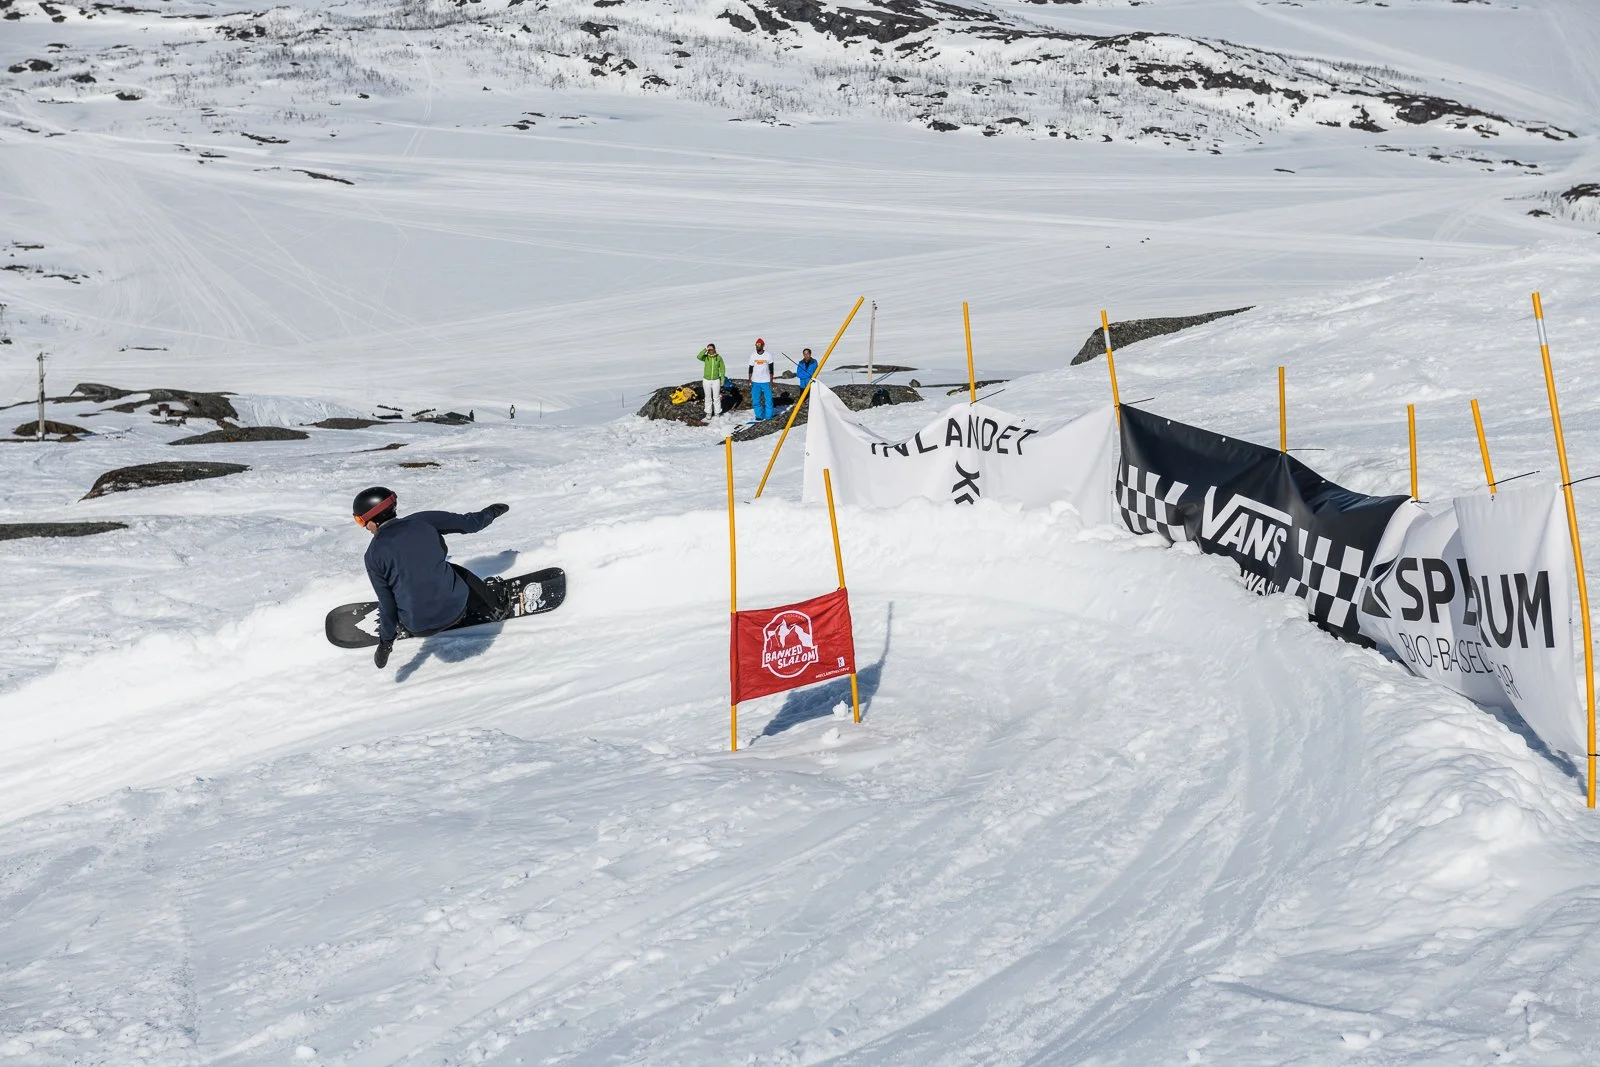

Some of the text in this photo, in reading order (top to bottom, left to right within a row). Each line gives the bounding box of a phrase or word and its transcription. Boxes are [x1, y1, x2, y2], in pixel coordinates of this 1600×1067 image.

[1201, 485, 1293, 568] VANS
[765, 644, 803, 663] BANKED
[777, 651, 816, 669] SLALOM
